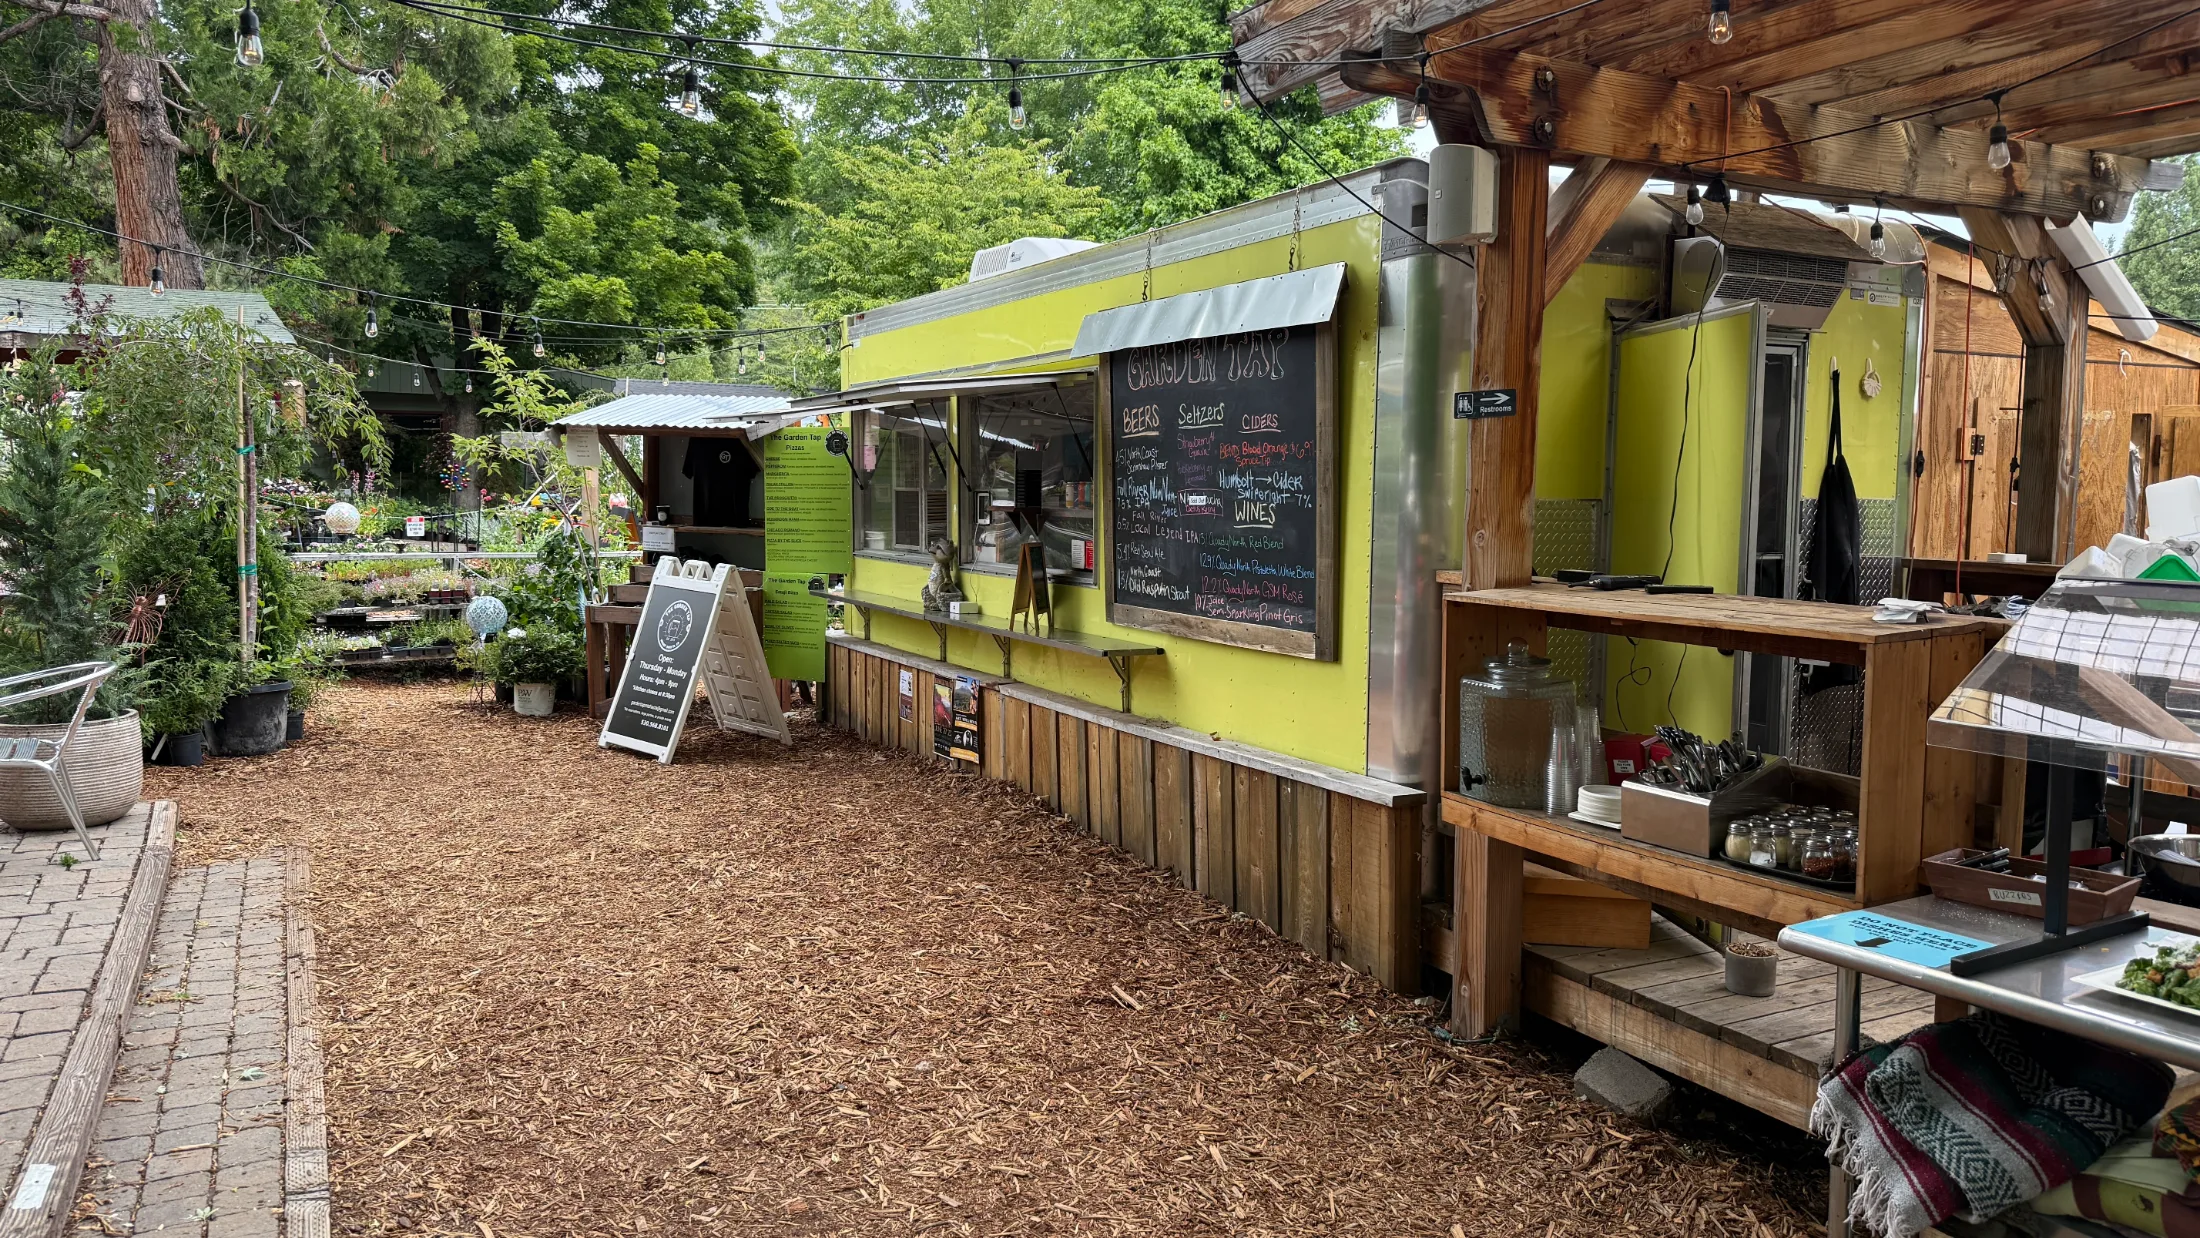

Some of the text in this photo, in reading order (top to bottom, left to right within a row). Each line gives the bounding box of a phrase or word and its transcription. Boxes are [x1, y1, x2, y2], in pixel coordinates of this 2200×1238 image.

[1128, 327, 1289, 391] GARDEN TAP
[1178, 402, 1225, 424] Seltzers
[1480, 405, 1512, 413] Restrooms
[1123, 404, 1160, 433] BEERS
[1242, 414, 1278, 430] CIDERS
[809, 434, 821, 442] Tap
[1177, 433, 1211, 450] Strawberry
[1141, 445, 1159, 460] Coast
[1242, 441, 1262, 455] Blood
[1263, 442, 1289, 460] Orange
[1235, 456, 1271, 467] Spruce Tip
[1135, 497, 1150, 510] IPA
[1295, 493, 1312, 508] 7%
[1132, 510, 1146, 521] Fall
[1234, 500, 1276, 524] WINES
[1185, 530, 1199, 543] IPA
[1229, 535, 1248, 548] North
[1249, 536, 1262, 550] Red
[1263, 536, 1284, 550] Blend
[1130, 541, 1141, 555] Red
[1141, 544, 1153, 558] Seal
[1154, 546, 1166, 561] Ale
[1130, 566, 1144, 578] North
[1144, 564, 1162, 577] Coast
[1236, 557, 1251, 572] North
[1296, 565, 1315, 579] Blend
[1128, 577, 1190, 600] Old Rasputin Stout
[1243, 580, 1260, 596] North
[1261, 580, 1280, 598] GSM
[1282, 584, 1304, 603] Rosé
[1259, 603, 1282, 621] Pinot
[1283, 608, 1304, 625] Gris
[658, 653, 674, 664] Open:
[639, 661, 663, 673] Thursday
[666, 666, 687, 679] Monday
[639, 674, 655, 683] Hours:
[655, 677, 665, 686] 4pm
[1849, 919, 1911, 937] DISHES
[1914, 935, 1966, 951] HERE
[1882, 922, 1919, 933] NOT
[1922, 932, 1978, 949] PLACE
